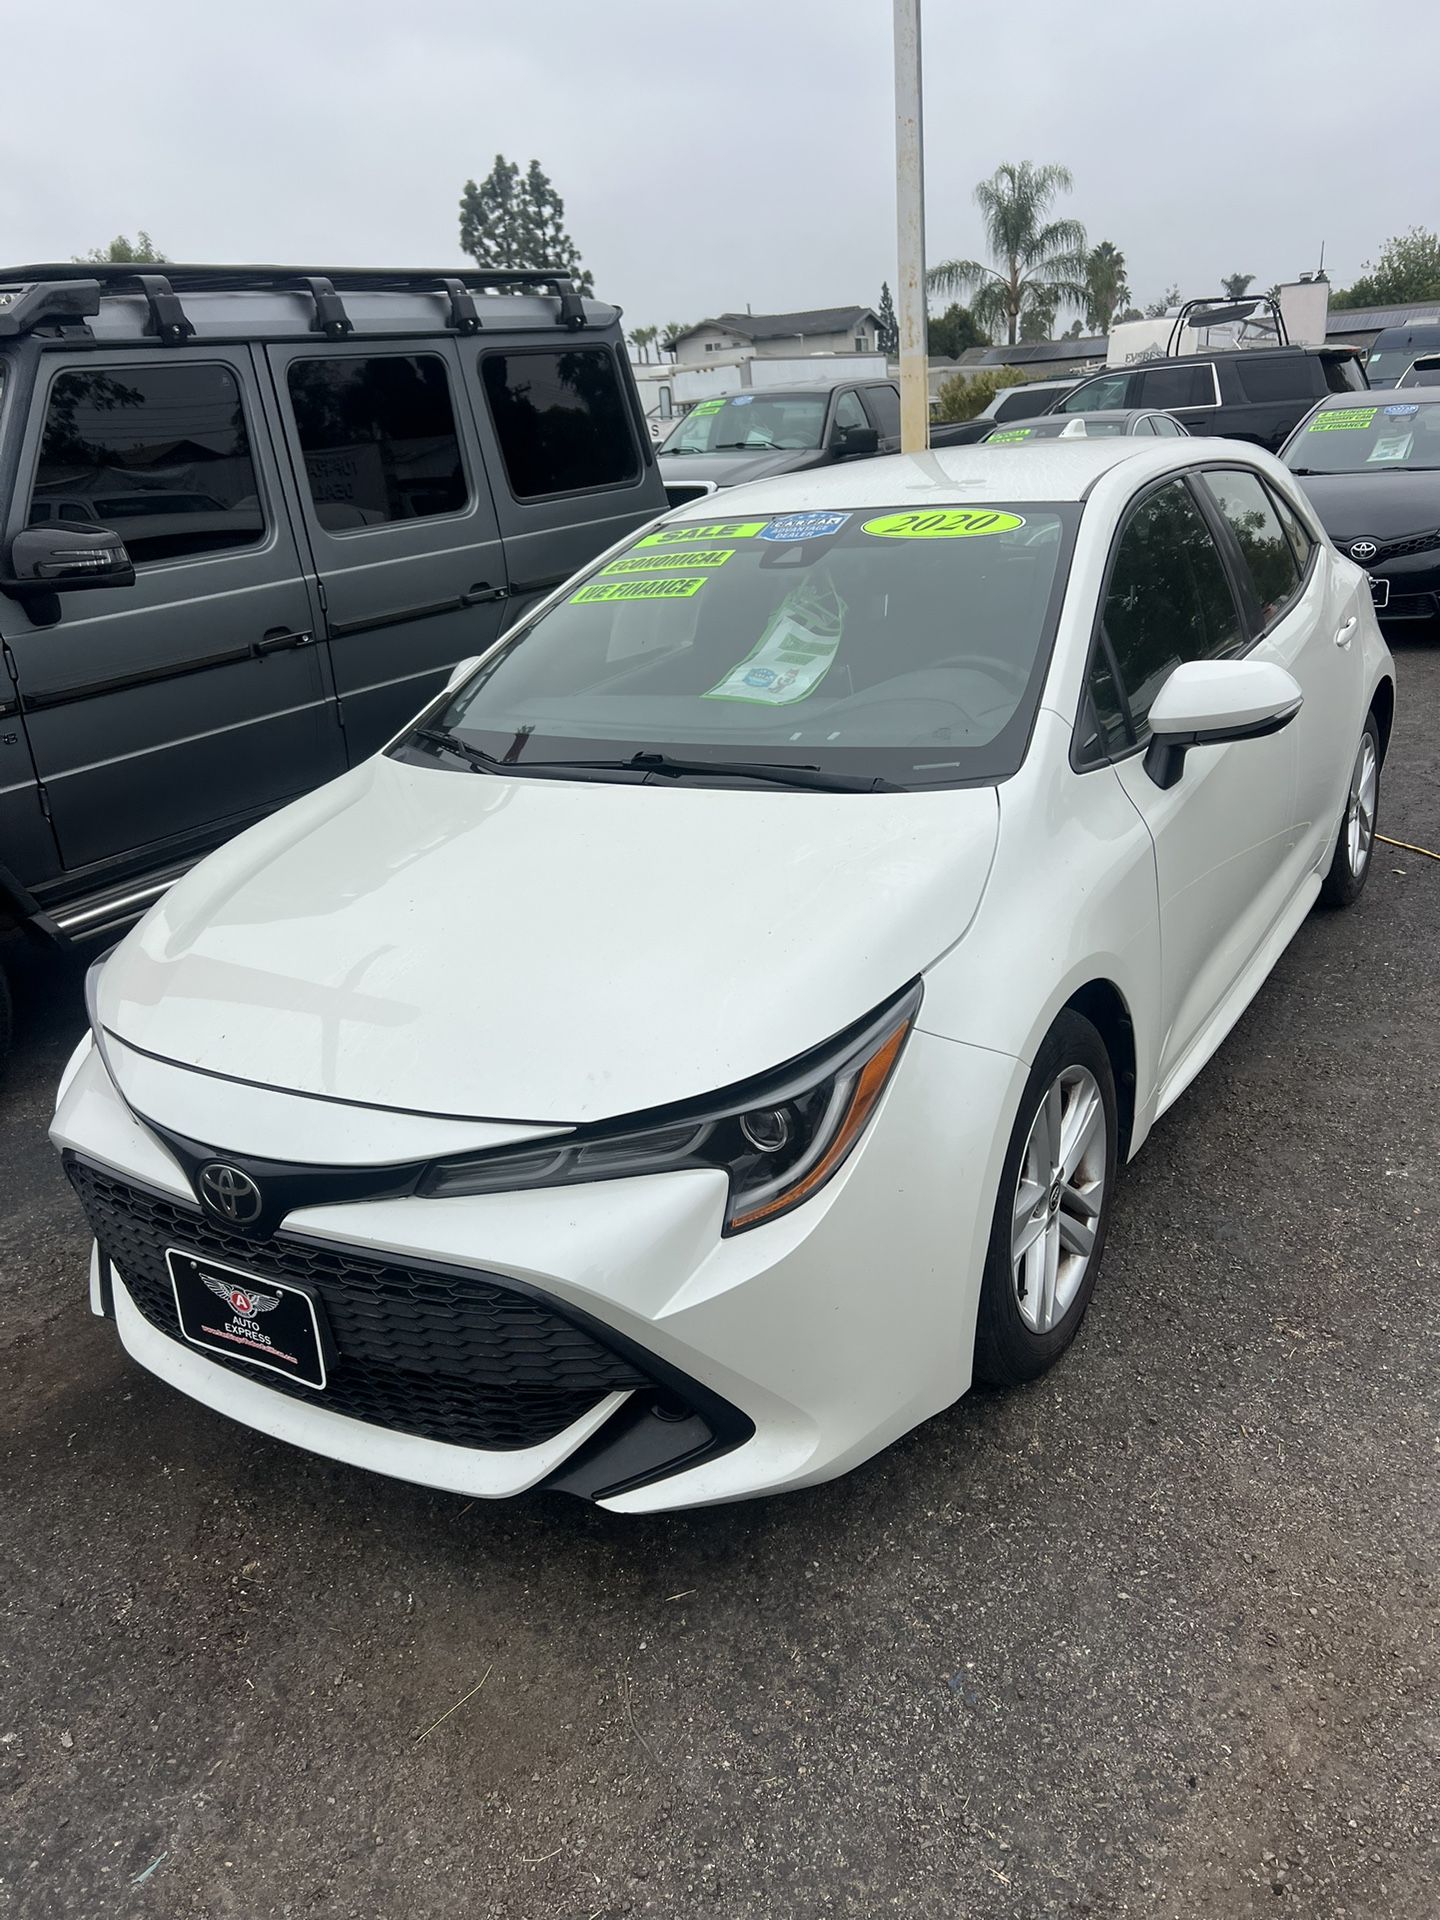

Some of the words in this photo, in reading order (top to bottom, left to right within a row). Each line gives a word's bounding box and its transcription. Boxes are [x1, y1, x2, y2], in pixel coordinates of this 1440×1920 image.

[656, 524, 744, 543] SALE
[770, 525, 829, 534] ADVANTAGE
[882, 513, 1001, 534] 2020
[774, 531, 815, 539] DEALER
[607, 551, 723, 573] ECONOMICAL
[579, 584, 611, 600] WE
[607, 577, 696, 598] FINANCE
[224, 1322, 272, 1345] EXPRESS
[232, 1315, 260, 1332] AUTO
